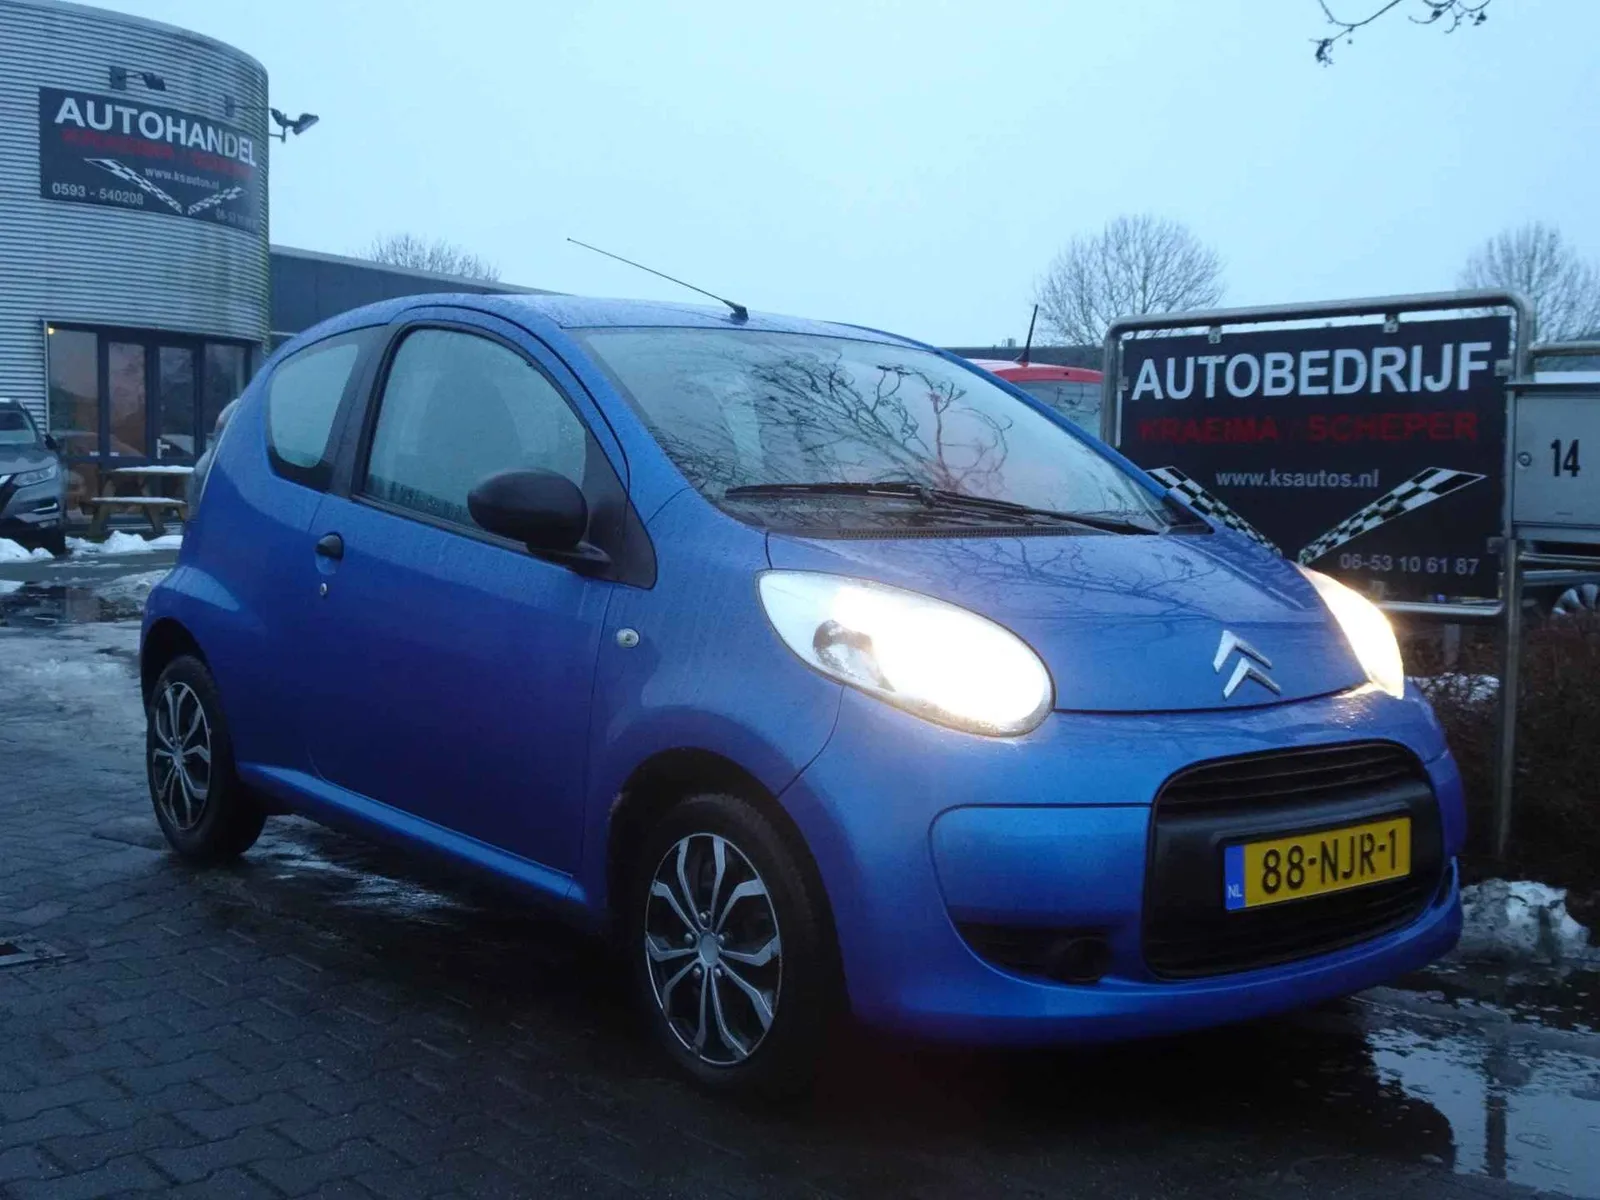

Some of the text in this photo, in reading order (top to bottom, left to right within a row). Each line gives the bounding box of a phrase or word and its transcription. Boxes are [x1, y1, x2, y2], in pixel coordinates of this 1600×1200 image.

[55, 97, 257, 168] AUTOHANDEL
[52, 182, 86, 198] 0593
[1131, 341, 1492, 401] AUTOBEDRIJF
[1139, 411, 1479, 444] KRAEIMA SCHEPER
[1550, 438, 1581, 478] 14
[1215, 468, 1380, 488] www.ksautos.nl
[1399, 555, 1421, 573] 10
[1425, 556, 1448, 574] 61
[1454, 557, 1480, 576] 87
[1261, 828, 1397, 895] 88-NJR-1
[1227, 884, 1243, 900] NL
